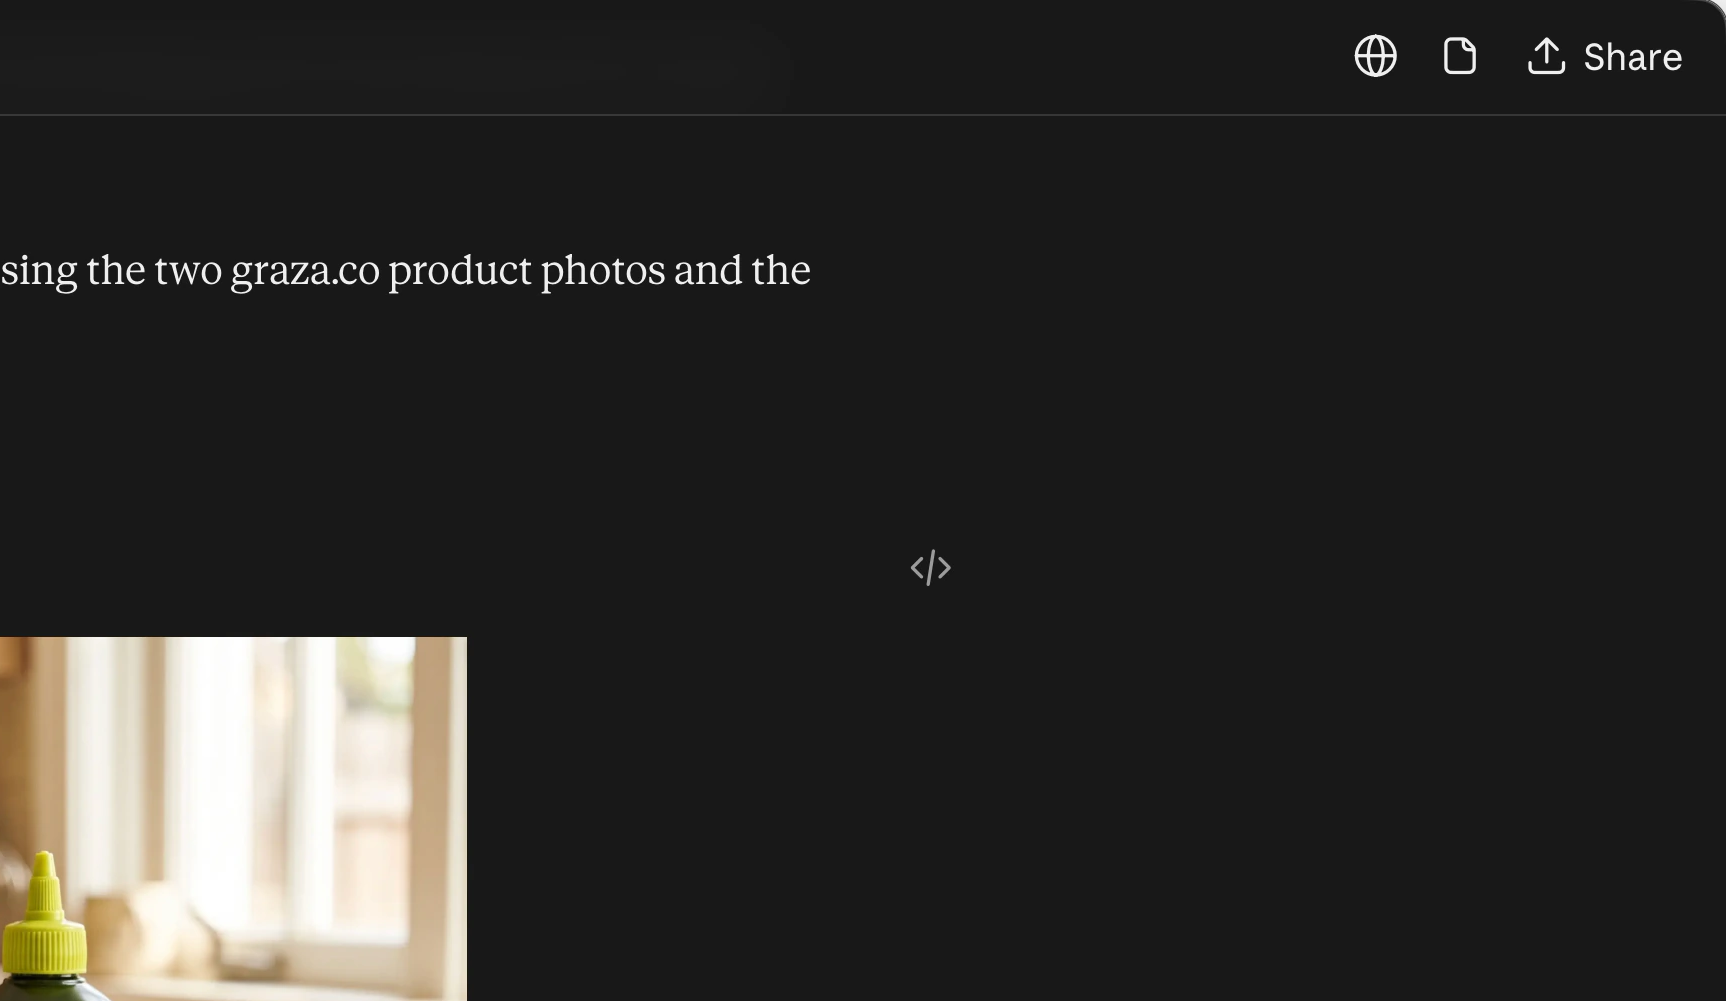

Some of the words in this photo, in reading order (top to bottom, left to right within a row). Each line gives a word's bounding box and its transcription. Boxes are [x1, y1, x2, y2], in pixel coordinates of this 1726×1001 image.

[1585, 42, 1682, 71] Share
[87, 254, 145, 285] the
[155, 258, 222, 285] two
[231, 262, 379, 294] graza.co
[389, 254, 532, 294] product
[541, 254, 665, 294] photos
[675, 254, 743, 285] and
[752, 254, 810, 285] the
